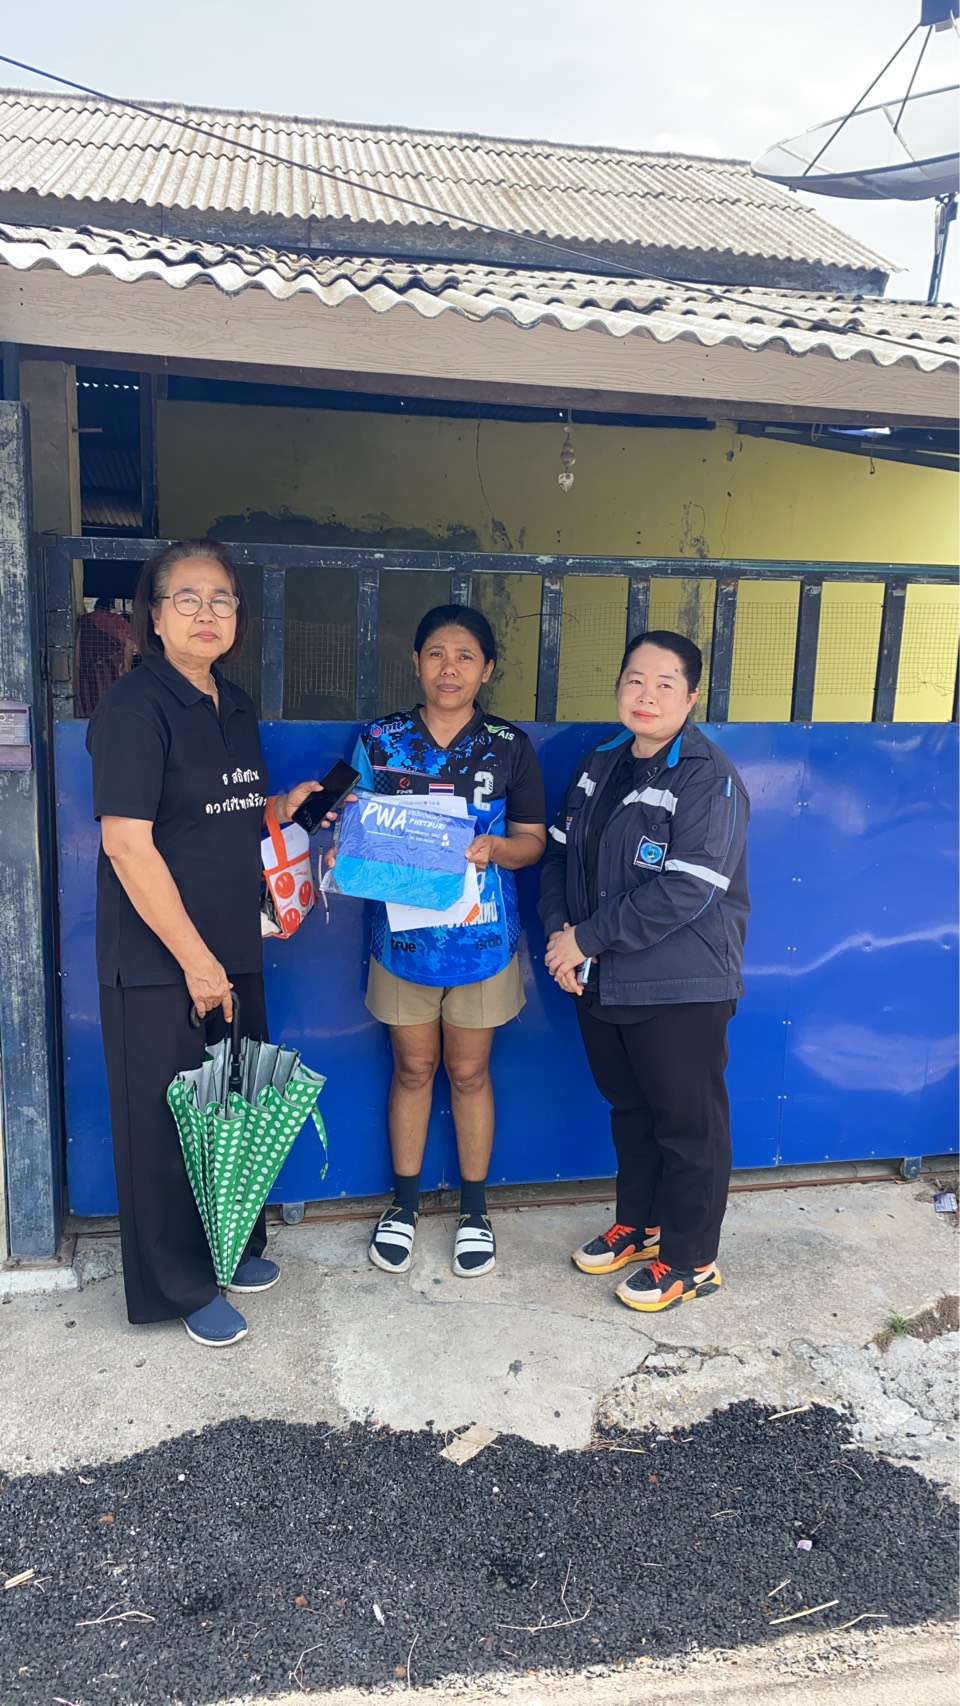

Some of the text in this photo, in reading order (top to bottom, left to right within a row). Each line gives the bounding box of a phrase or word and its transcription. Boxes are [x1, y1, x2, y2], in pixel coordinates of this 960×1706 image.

[497, 729, 515, 740] AIS
[473, 771, 494, 811] 2
[360, 801, 408, 831] PWA
[408, 818, 446, 830] PHETBURI
[390, 937, 416, 953] true
[475, 935, 503, 951] Grab
